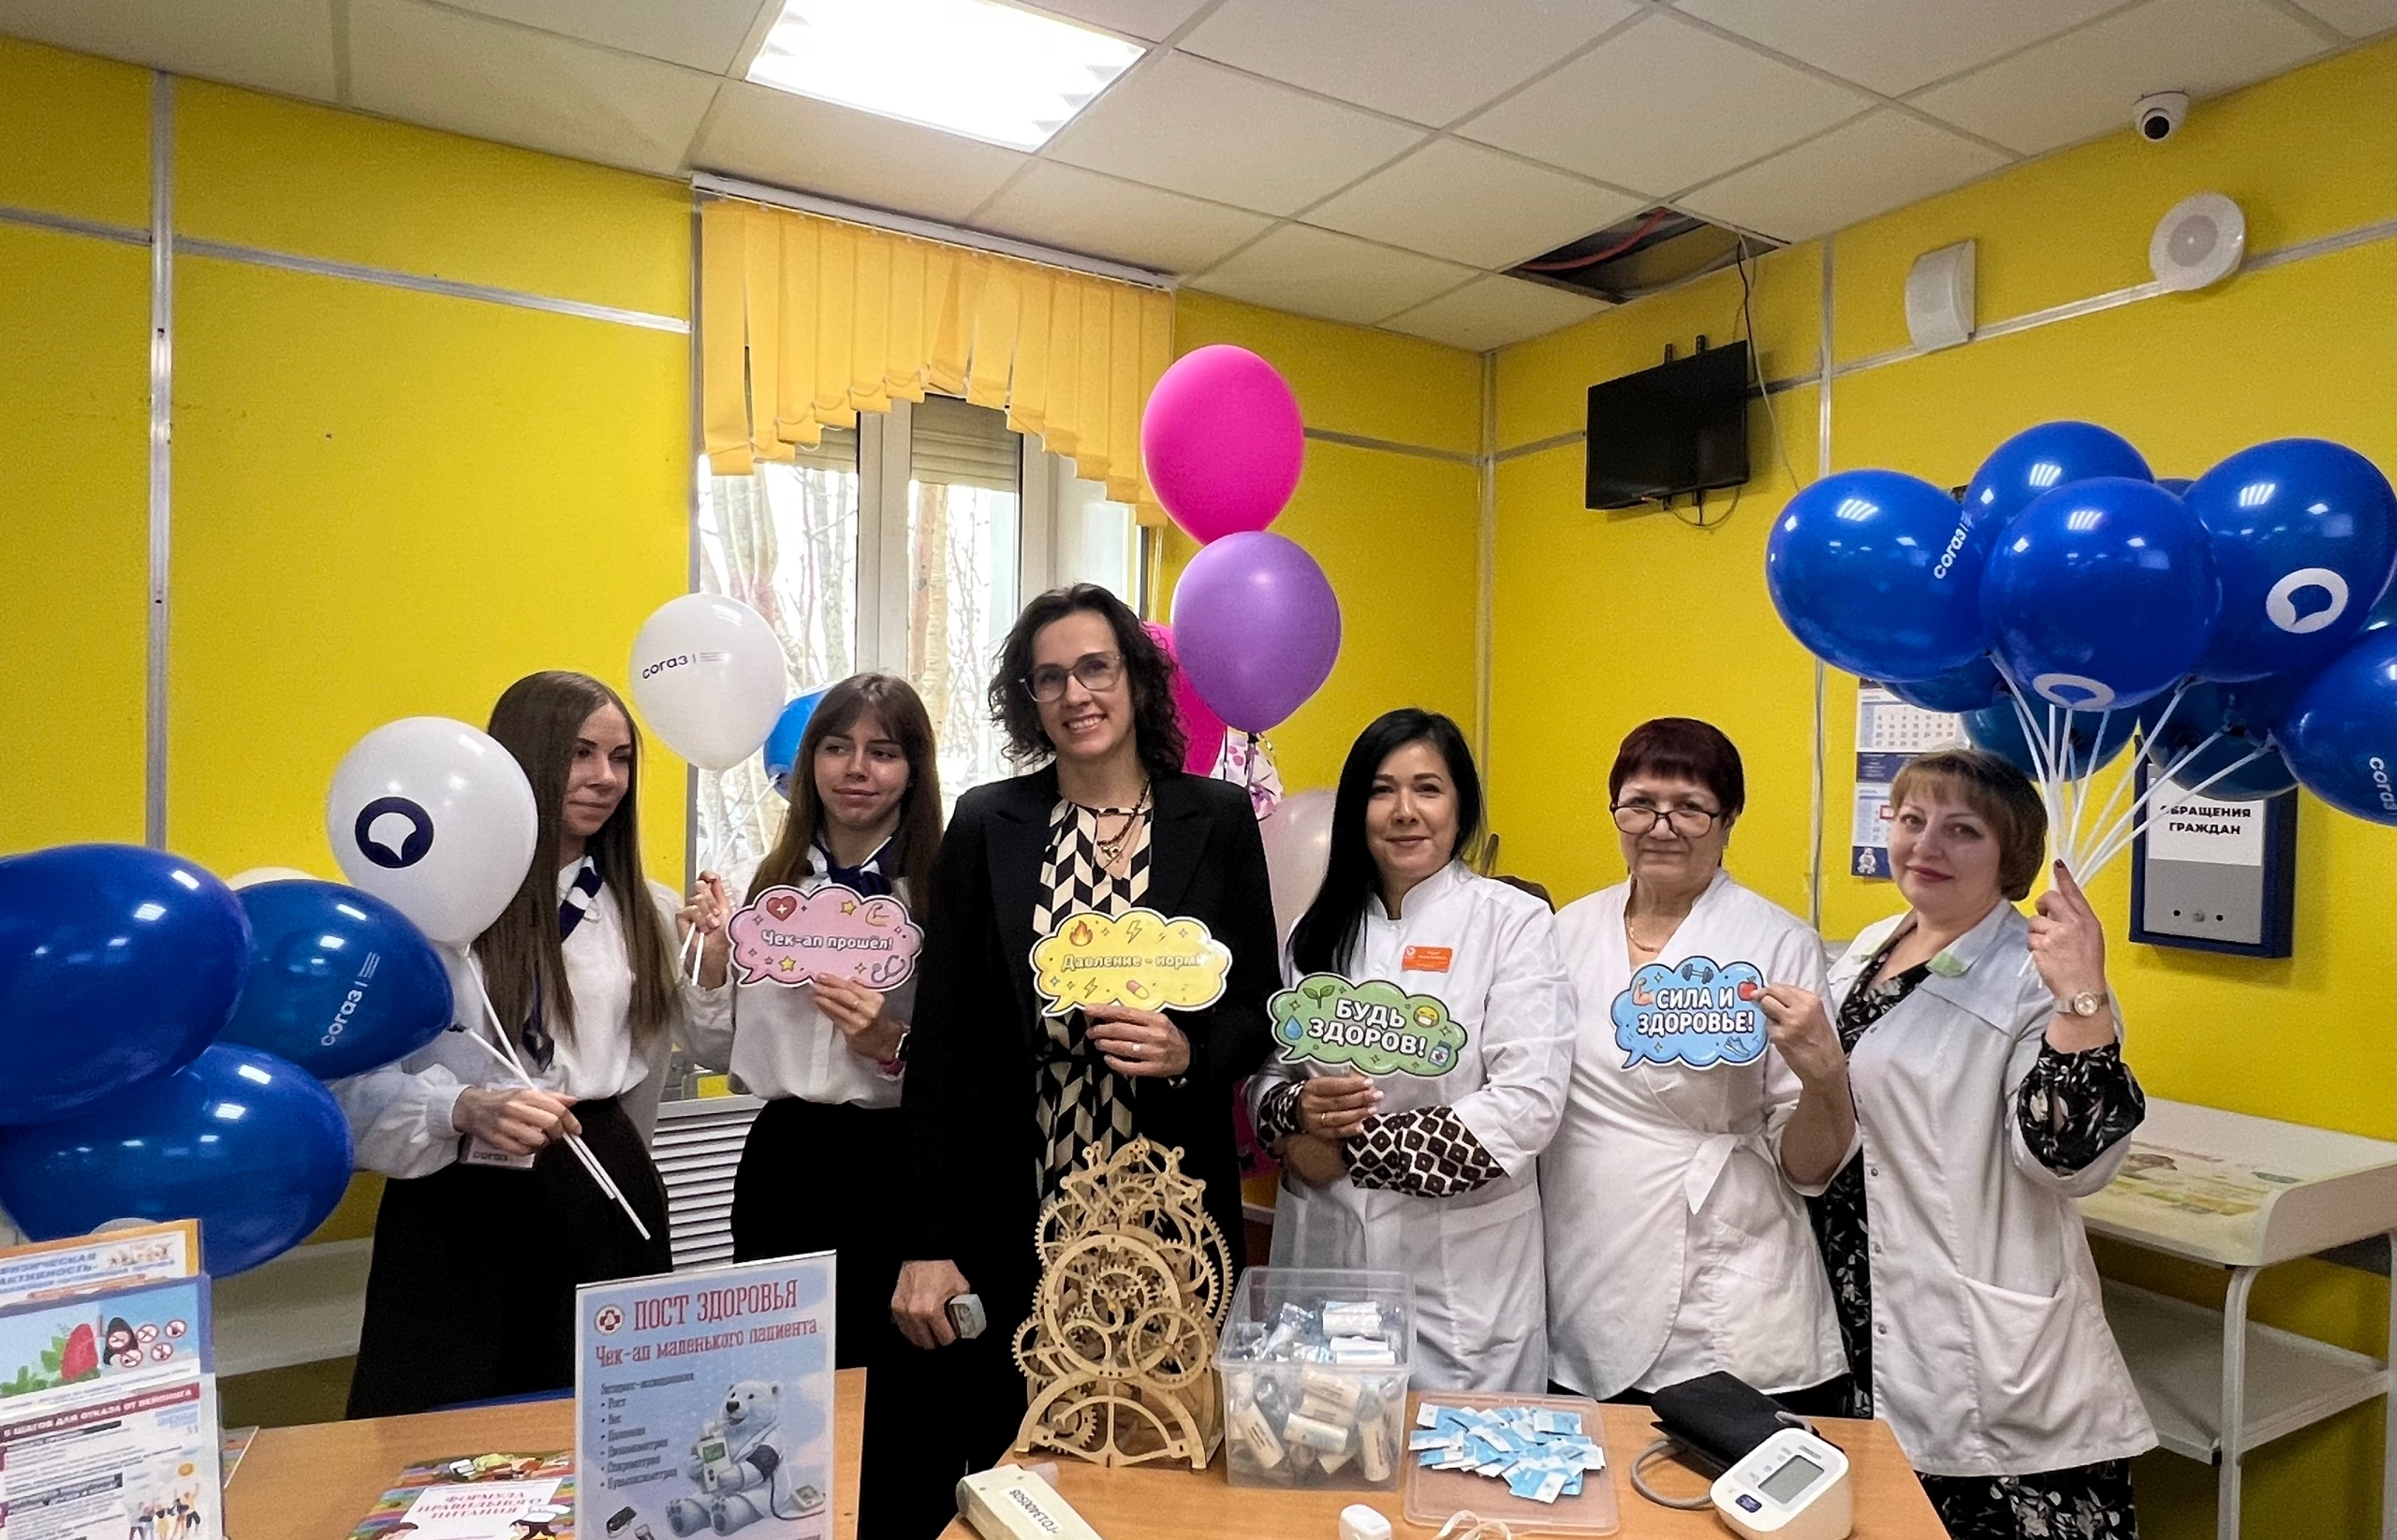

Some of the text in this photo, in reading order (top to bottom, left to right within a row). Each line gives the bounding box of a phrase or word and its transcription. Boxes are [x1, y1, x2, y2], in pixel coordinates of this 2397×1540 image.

[1934, 528, 1966, 579] согаз
[642, 655, 688, 679] согаз
[2160, 805, 2251, 818] БРАЩЕНИЯ
[2169, 822, 2241, 835] ГРАЖДАН
[761, 930, 894, 950] Чек-ап прошёл!
[1061, 953, 1142, 972] Давление
[1656, 987, 1734, 1010] СИЛА И
[321, 990, 362, 1046] согаз
[1336, 998, 1406, 1029] БУДЬ
[1638, 1010, 1755, 1037] ЗДОРОВЬЕ!
[1307, 1017, 1428, 1058] ЗДОРОВ!
[634, 1279, 798, 1331] ПОСТ ЗДОРОВЬЯ
[596, 1318, 817, 1368] Чек-ап маленького пациента
